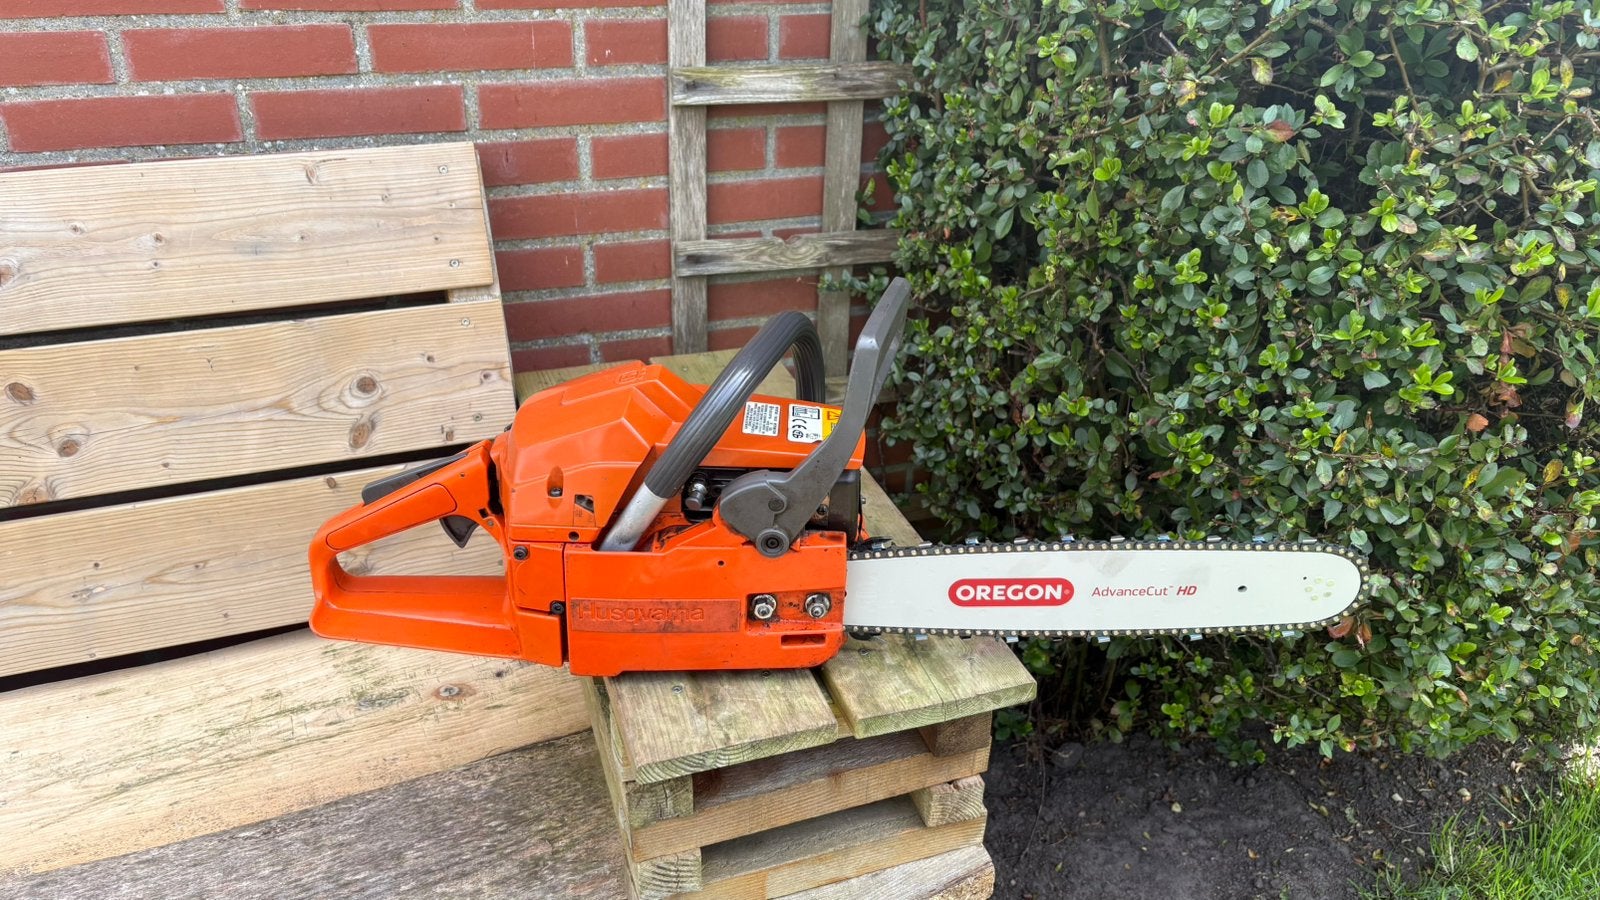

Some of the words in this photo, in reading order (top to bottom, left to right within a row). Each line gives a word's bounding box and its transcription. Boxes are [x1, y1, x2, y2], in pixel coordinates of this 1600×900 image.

[955, 584, 1063, 601] OREGON
[1176, 585, 1198, 596] HD
[577, 602, 705, 624] Husqvarna
